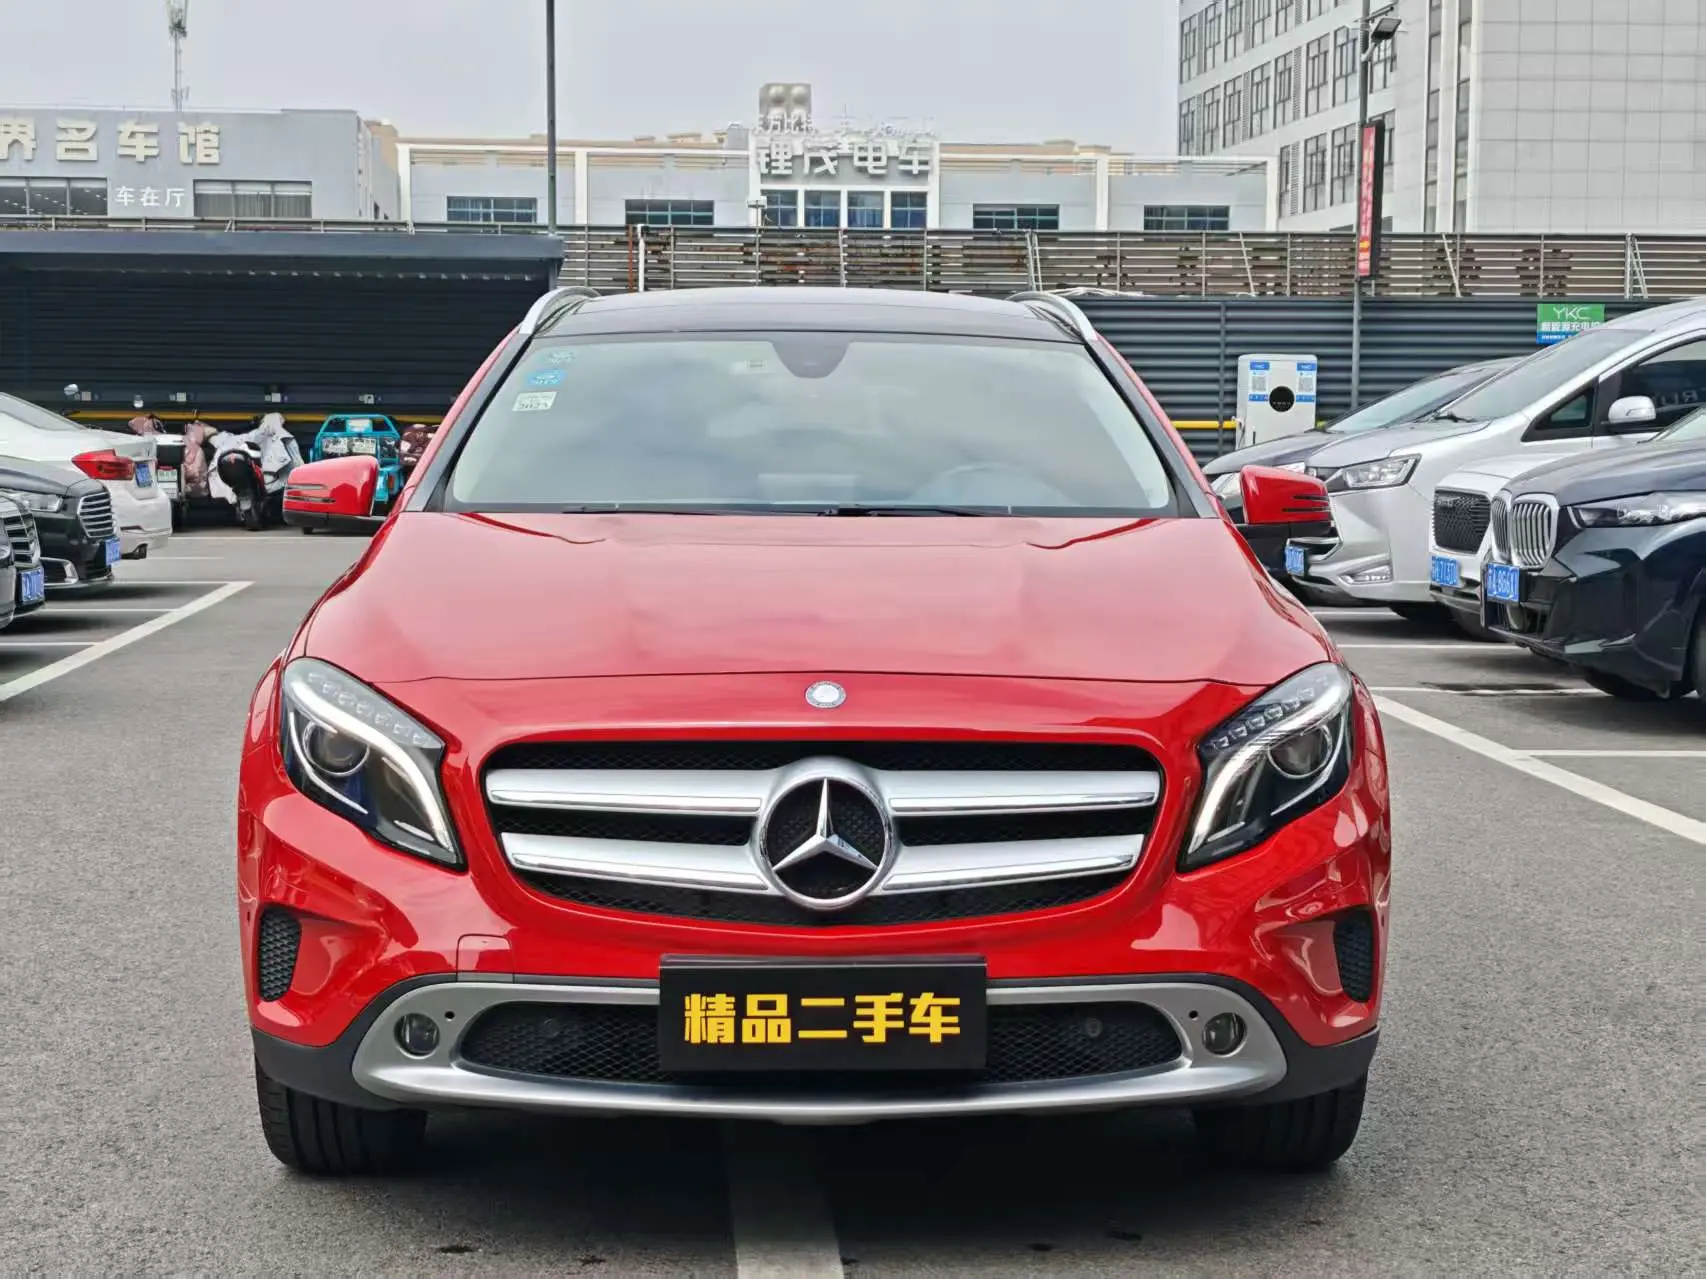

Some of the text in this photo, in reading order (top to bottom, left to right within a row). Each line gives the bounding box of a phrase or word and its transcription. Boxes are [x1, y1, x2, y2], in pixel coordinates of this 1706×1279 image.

[114, 185, 187, 207] 车在厅
[1552, 306, 1591, 320] YKC
[684, 992, 961, 1044] 精品二手车
